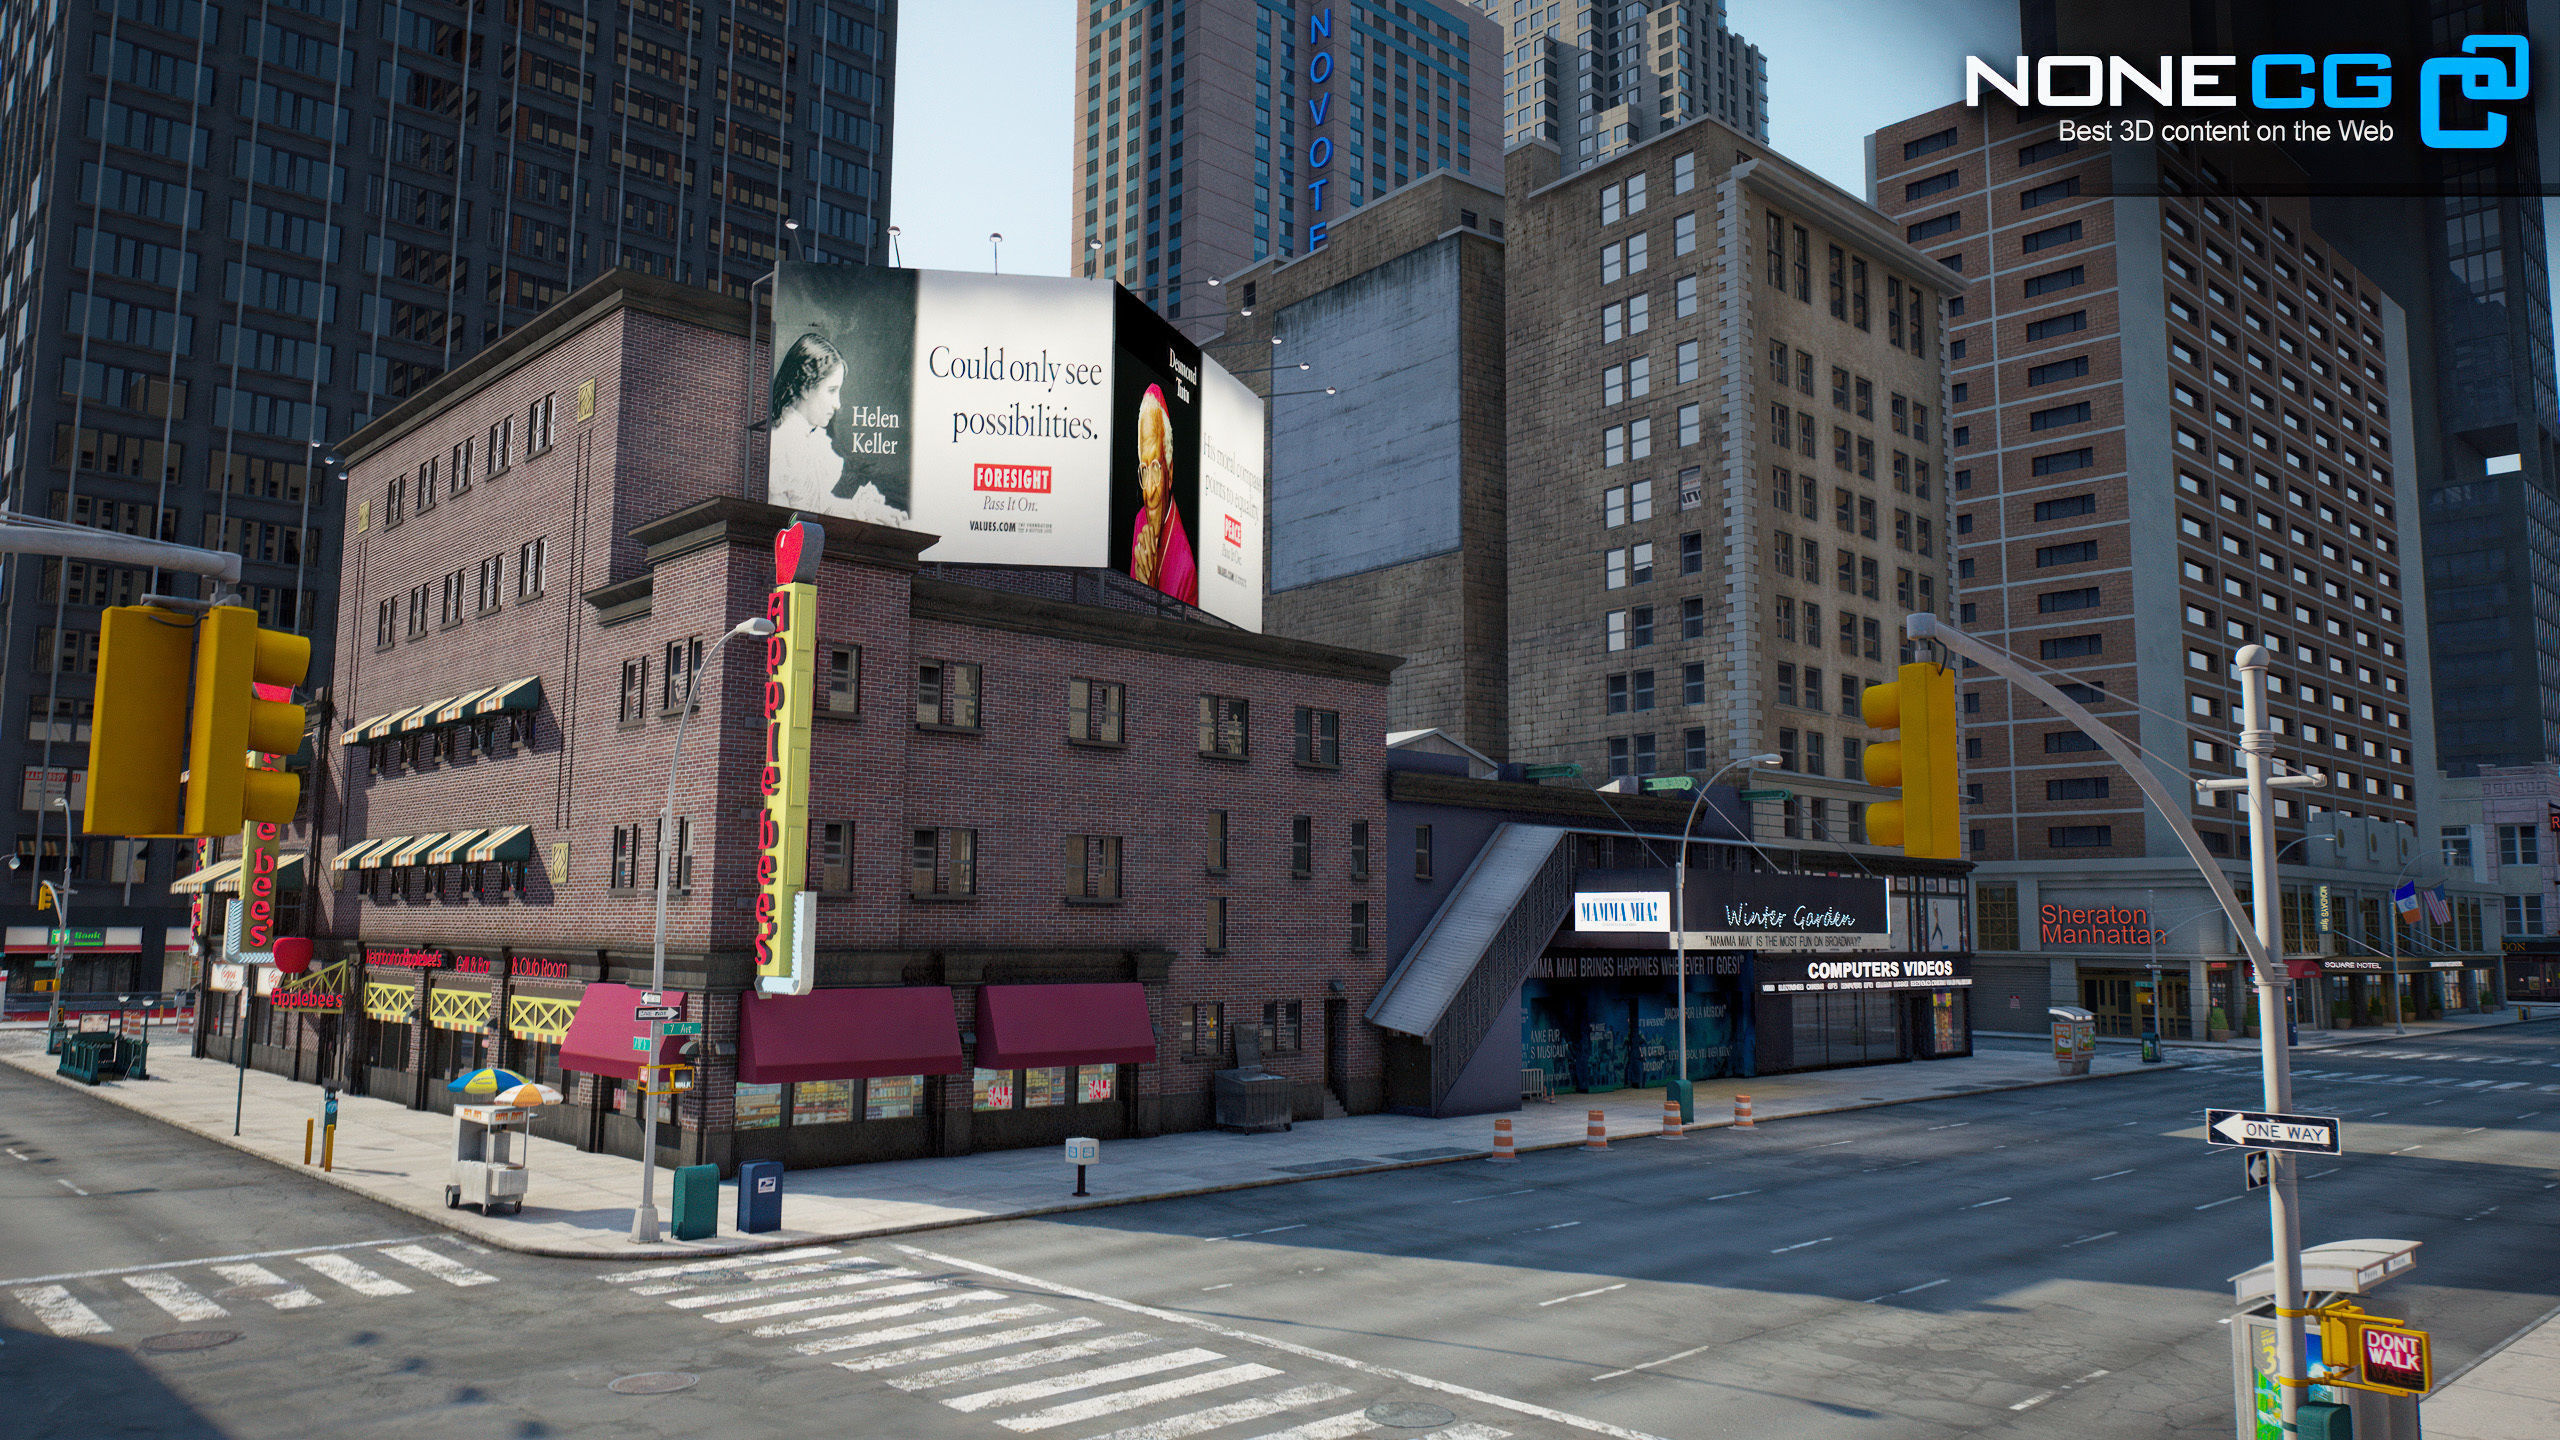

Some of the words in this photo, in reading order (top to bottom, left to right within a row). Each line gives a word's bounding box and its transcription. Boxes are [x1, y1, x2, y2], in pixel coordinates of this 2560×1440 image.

[930, 346, 1005, 381] Could
[1010, 350, 1061, 392] only
[1065, 363, 1102, 386] see
[1169, 348, 1197, 386] Desmond
[1176, 377, 1190, 404] Tutu
[851, 405, 900, 428] Helen
[952, 402, 1099, 444] possibilities.
[851, 432, 898, 455] Keller
[977, 467, 1049, 490] FORESIGHT
[983, 495, 1005, 511] Pass
[1007, 496, 1017, 511] It
[1018, 497, 1038, 512] On.
[969, 520, 1016, 532] VALUES.COM
[1224, 517, 1241, 545] PEACE
[1580, 902, 1627, 921] MAMMA
[1630, 901, 1658, 921] MIA!
[1725, 902, 1786, 930] Winter
[1793, 905, 1856, 930] Garden
[2041, 904, 2147, 924] Sheraton
[1756, 936, 1763, 947] IS
[1764, 936, 1778, 947] THE
[1779, 936, 1798, 947] MOST
[1799, 936, 1813, 947] FUN
[1814, 936, 1823, 947] ON
[2042, 924, 2167, 945] Manhattan
[478, 956, 492, 974] Bar
[512, 956, 518, 975] &
[519, 956, 539, 976] Club
[541, 958, 567, 978] Room
[1580, 957, 1614, 977] BRINGS
[1617, 956, 1659, 976] HAPPINES
[1661, 956, 1705, 976] WHEEVER
[1707, 956, 1714, 975] IT
[1807, 962, 1899, 979] COMPUTERS
[1903, 960, 1953, 977] VIDEOS
[988, 1086, 1012, 1099] SALE
[1088, 1079, 1110, 1092] SALE
[2246, 1123, 2280, 1138] ONE
[2287, 1126, 2324, 1142] WAY
[2367, 1330, 2419, 1354] DONT
[2263, 1345, 2277, 1375] 3
[2369, 1346, 2420, 1371] WALK
